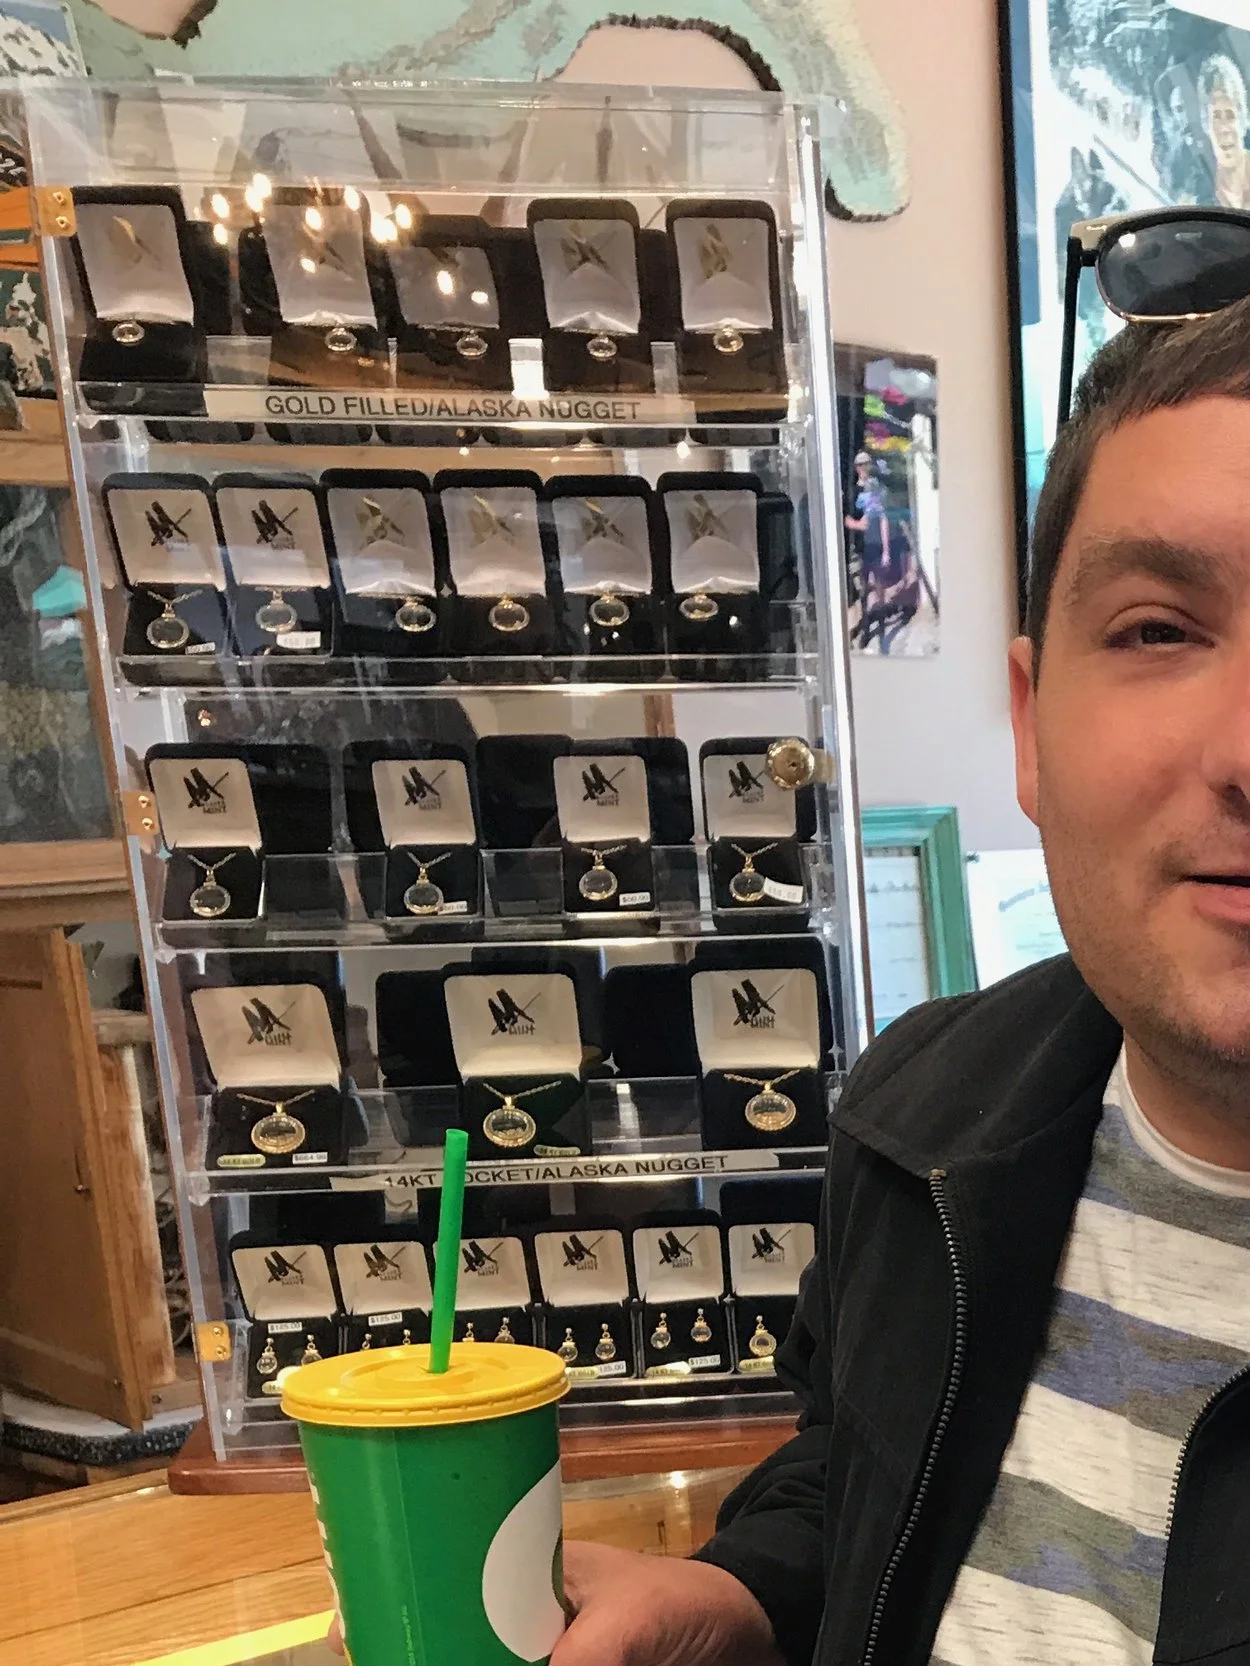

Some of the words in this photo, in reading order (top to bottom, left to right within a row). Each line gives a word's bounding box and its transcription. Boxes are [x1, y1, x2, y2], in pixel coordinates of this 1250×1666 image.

[265, 394, 336, 415] GOLD
[344, 396, 531, 419] FILLED/ALASKA
[538, 399, 642, 420] NUGGET
[385, 1172, 437, 1188] 14KT
[464, 1163, 628, 1187] OCKET/ALASKA
[635, 1155, 729, 1175] NUGGET
